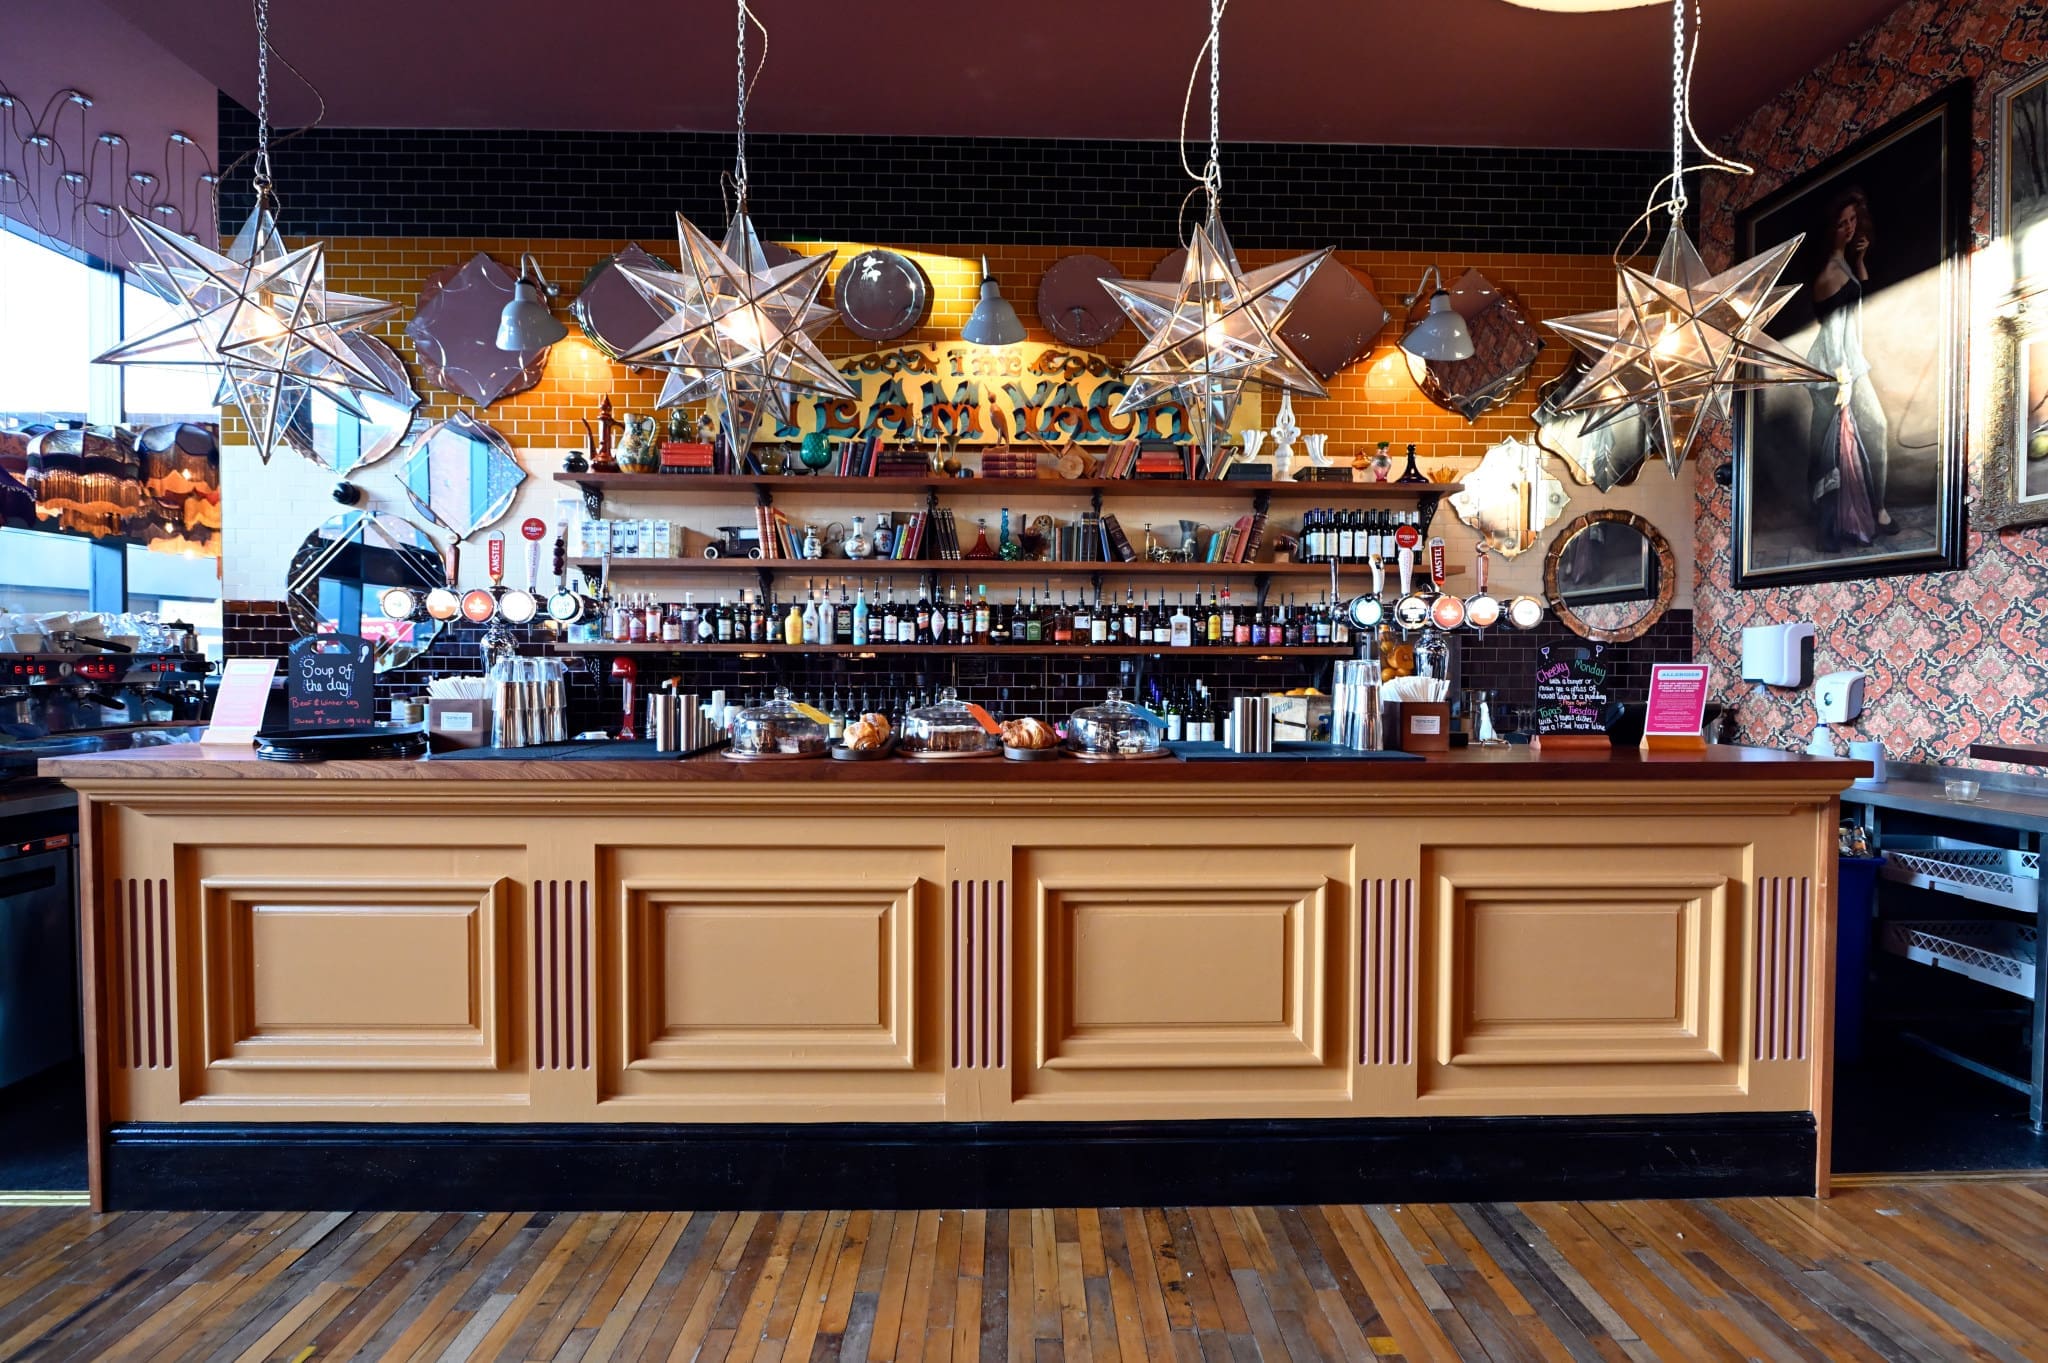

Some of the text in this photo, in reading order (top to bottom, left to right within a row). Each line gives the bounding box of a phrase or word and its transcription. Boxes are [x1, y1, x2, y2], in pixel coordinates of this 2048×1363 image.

[492, 541, 500, 571] AMSTEL
[1435, 548, 1443, 578] AMSTEL
[303, 659, 352, 680] Soup of
[1537, 660, 1606, 685] Cheeky Monday
[306, 678, 348, 696] the day
[1538, 706, 1598, 722] Tapas Tuesday
